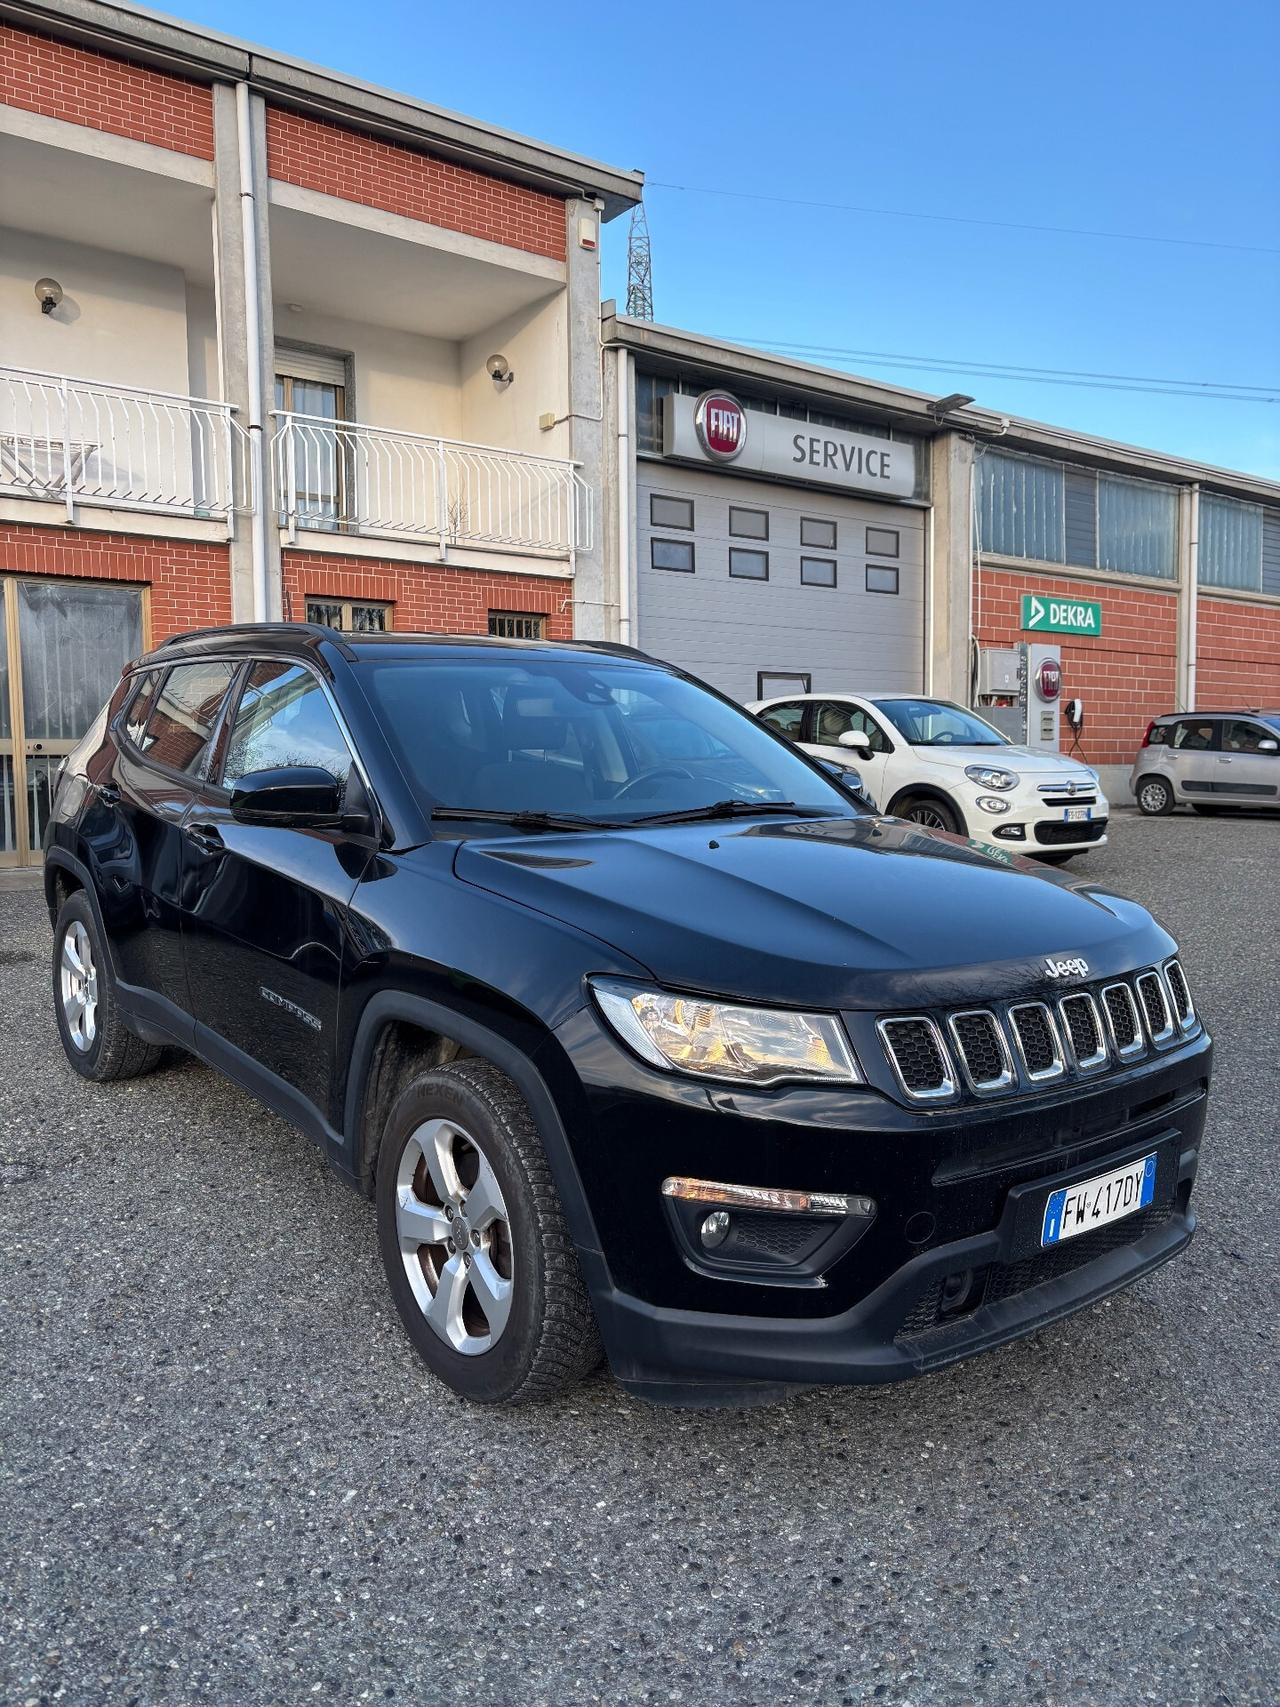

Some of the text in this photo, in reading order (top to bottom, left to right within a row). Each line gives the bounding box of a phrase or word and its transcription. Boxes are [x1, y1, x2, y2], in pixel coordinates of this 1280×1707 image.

[710, 408, 739, 442] FIAT
[792, 434, 891, 480] SERVICE
[1050, 603, 1095, 628] DEKRA
[1045, 957, 1089, 978] Jeep
